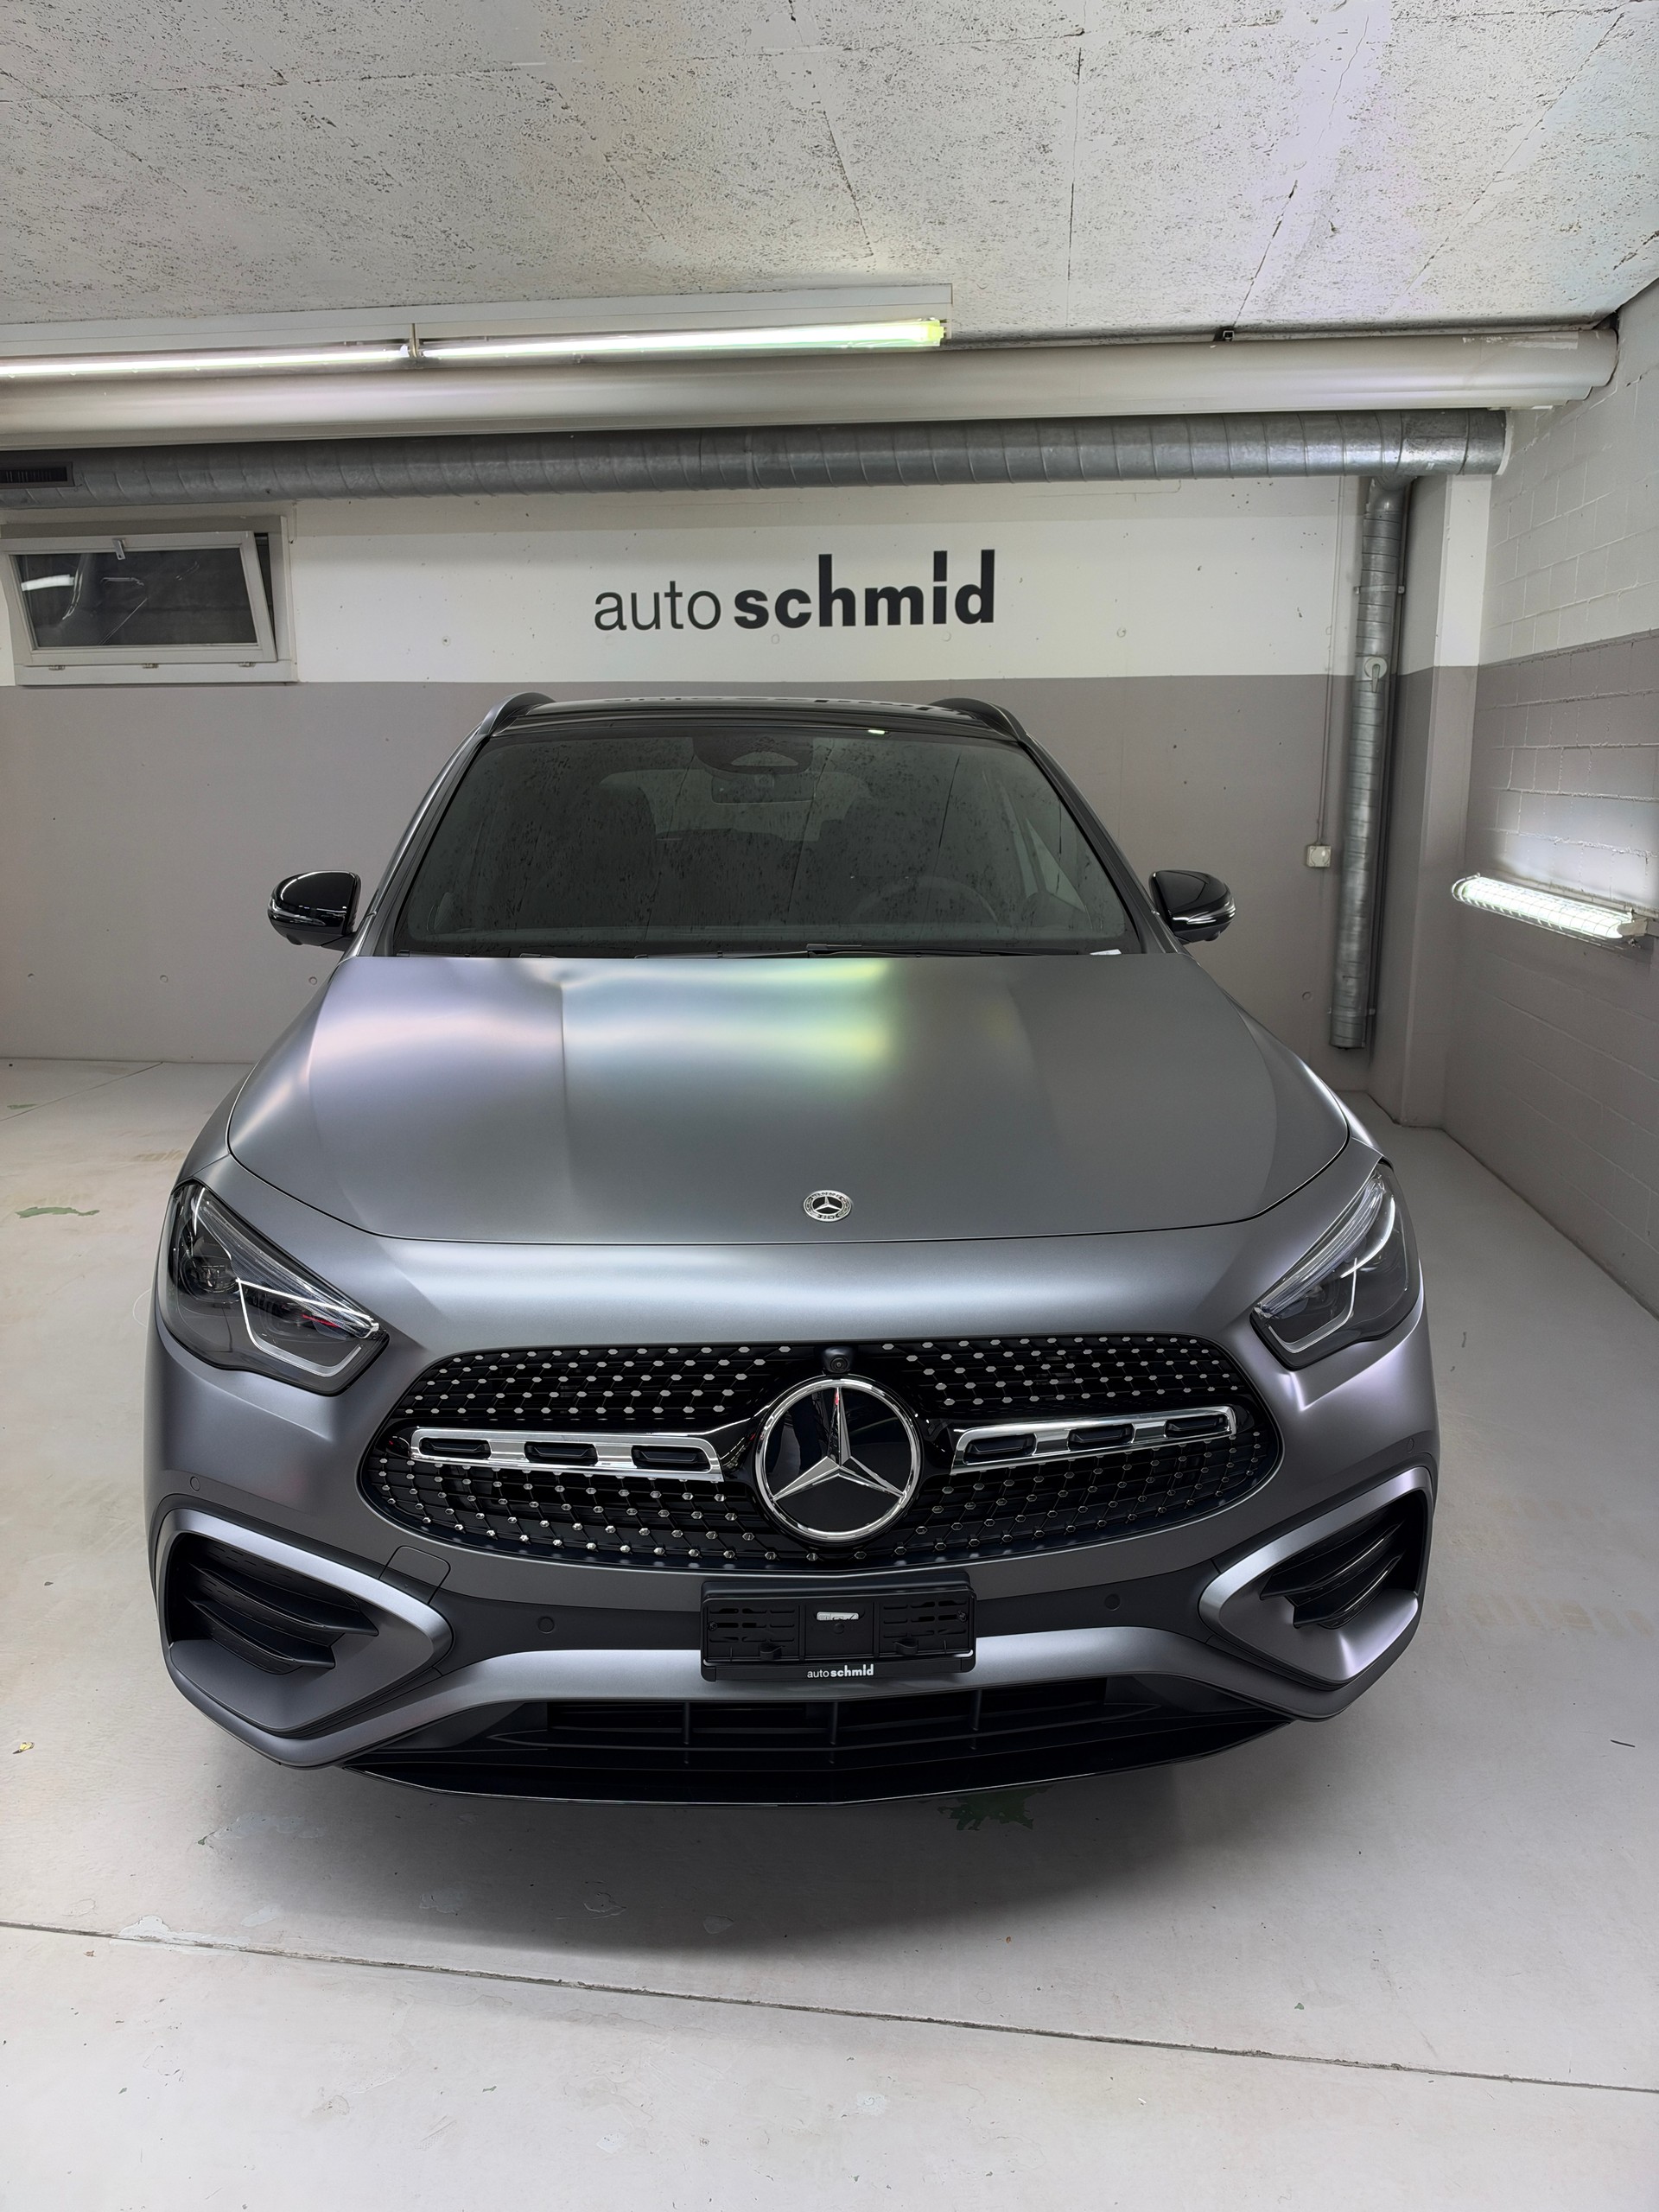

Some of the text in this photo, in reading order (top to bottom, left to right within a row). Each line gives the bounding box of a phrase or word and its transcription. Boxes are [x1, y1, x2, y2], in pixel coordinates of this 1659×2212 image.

[594, 549, 995, 631] auto schmid
[807, 1663, 874, 1678] auto schmid
